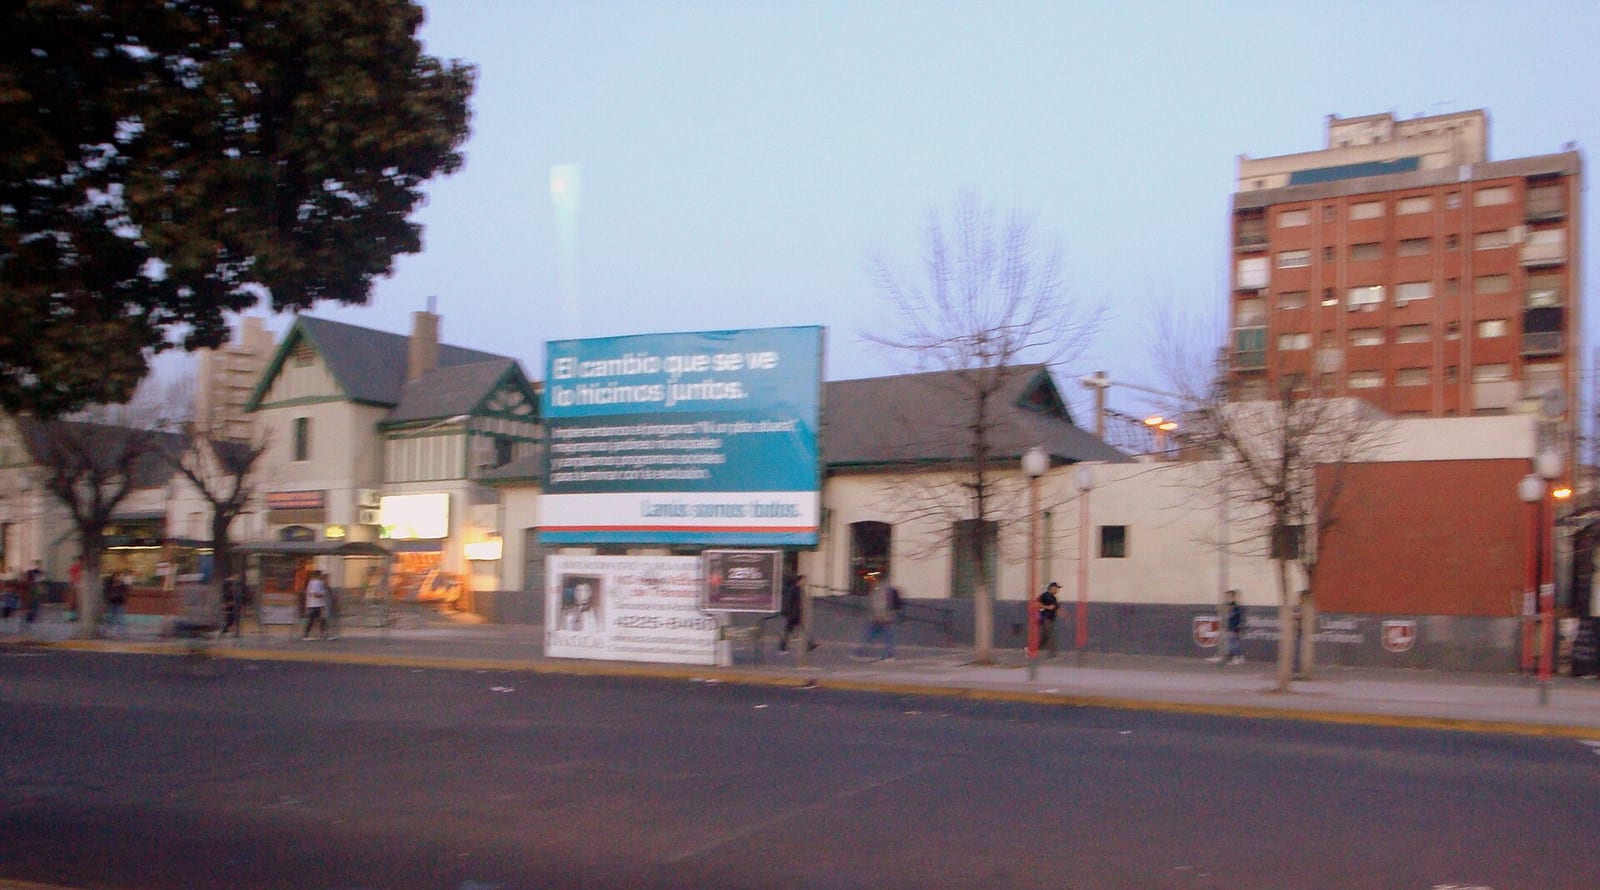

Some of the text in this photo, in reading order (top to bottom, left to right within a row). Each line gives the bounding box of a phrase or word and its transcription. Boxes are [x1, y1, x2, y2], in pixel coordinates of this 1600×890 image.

[553, 350, 779, 379] El cambio que se ve
[552, 377, 748, 407] lo hicimos juntos.
[691, 503, 745, 518] somos
